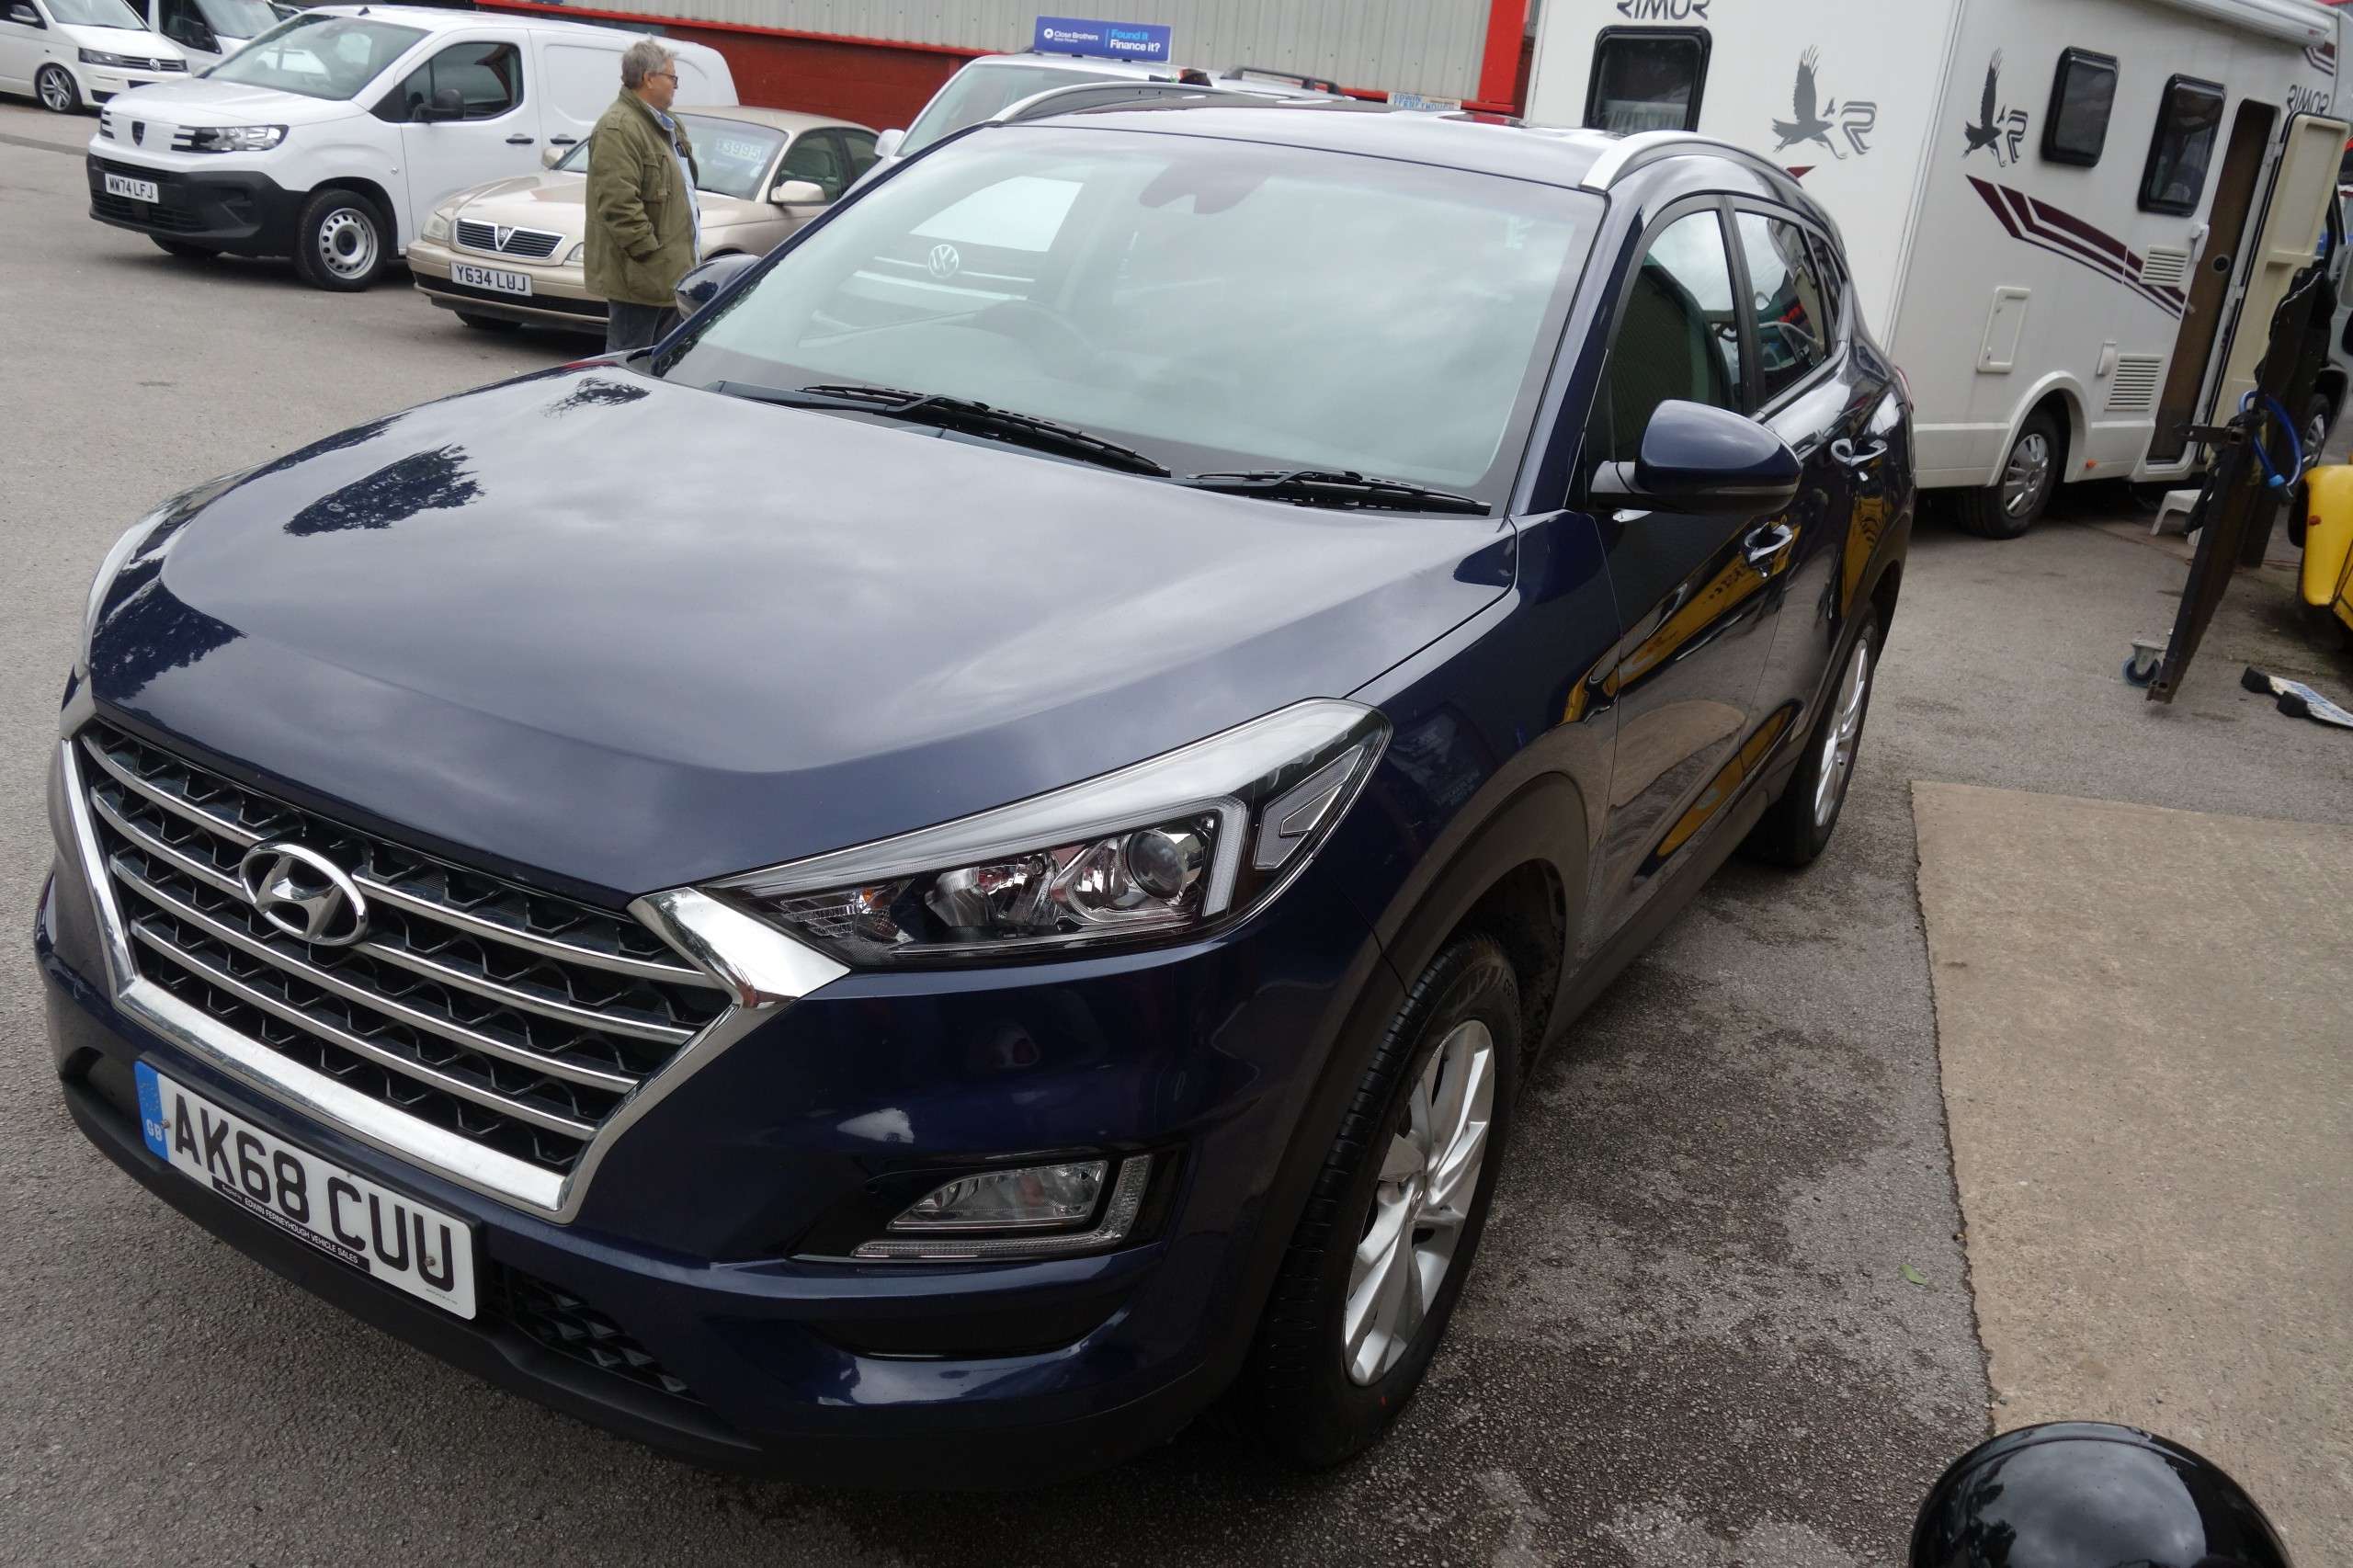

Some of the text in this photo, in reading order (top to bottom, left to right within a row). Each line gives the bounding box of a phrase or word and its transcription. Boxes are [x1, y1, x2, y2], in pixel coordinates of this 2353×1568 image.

[1072, 32, 1099, 41] Brothers
[1111, 29, 1140, 40] Found
[1109, 40, 1161, 52] Finance it?
[133, 182, 153, 199] LFJ
[456, 264, 526, 292] Y634 LUJ
[145, 1119, 164, 1142] GB
[175, 1093, 455, 1292] AK68 CUU
[244, 1198, 265, 1215] EDWIN
[266, 1210, 310, 1239] FERNEYHOUGH
[311, 1233, 336, 1252] VEHICLE
[337, 1247, 358, 1264] SALES
